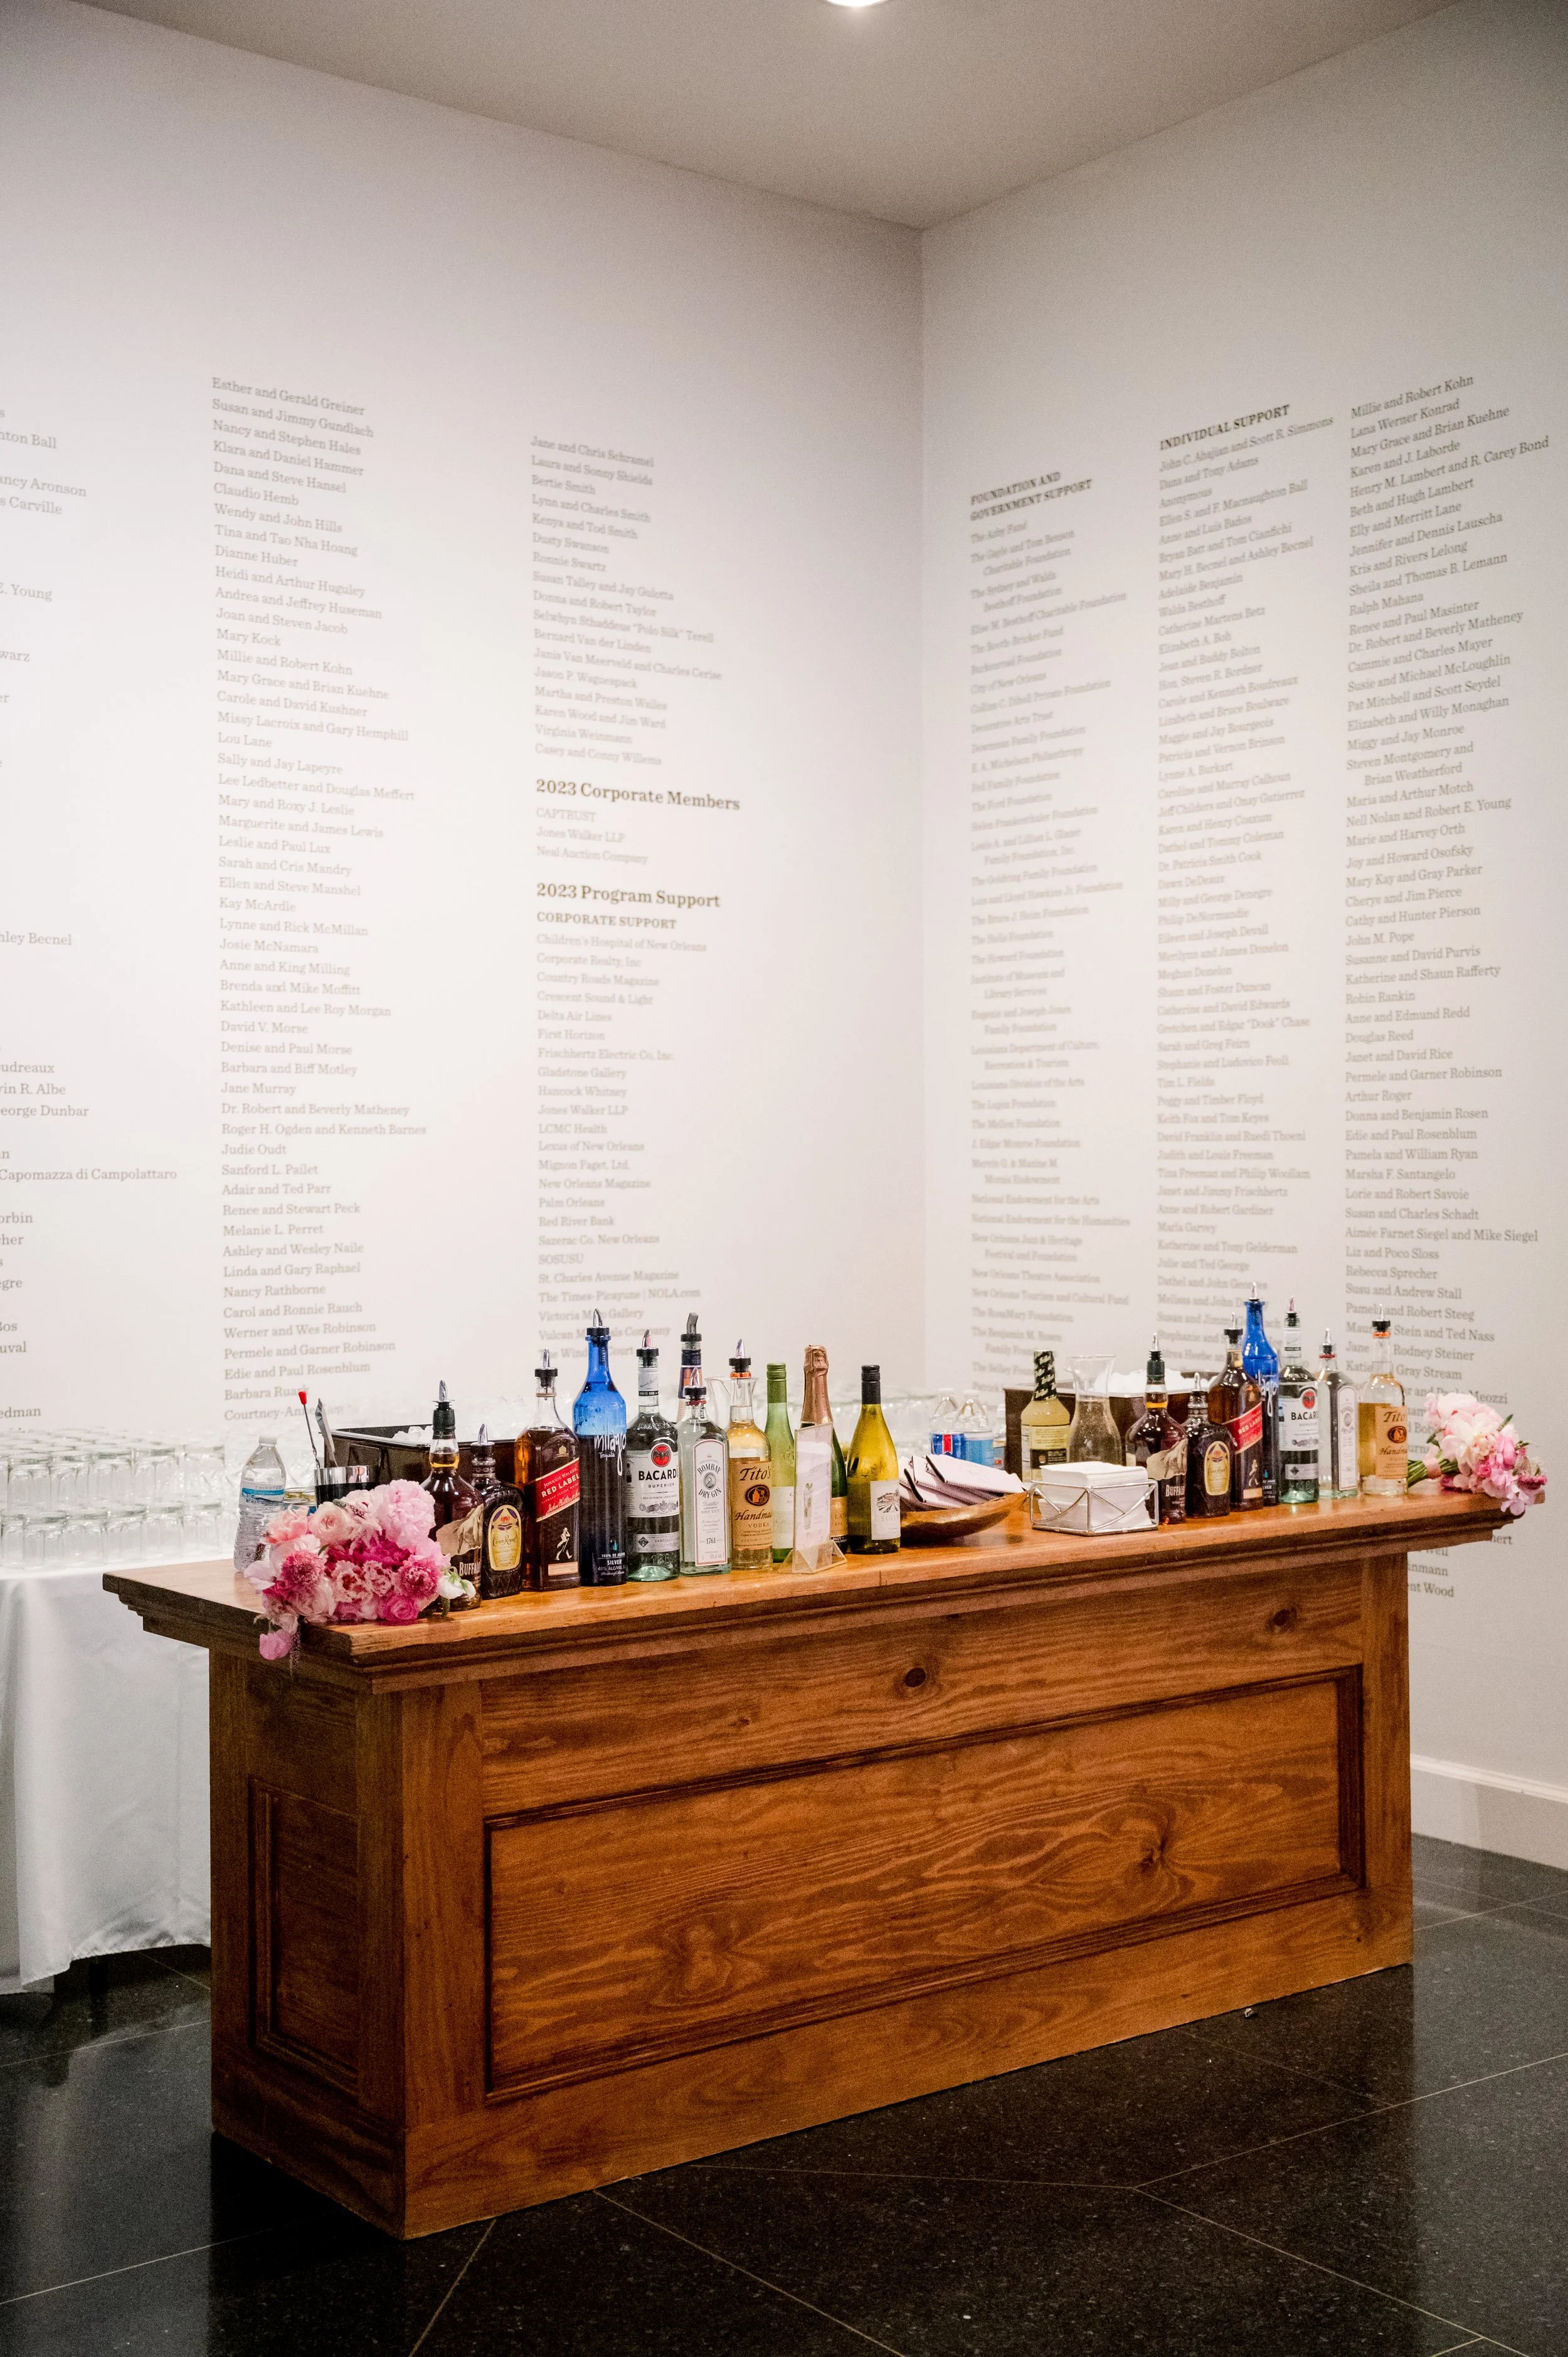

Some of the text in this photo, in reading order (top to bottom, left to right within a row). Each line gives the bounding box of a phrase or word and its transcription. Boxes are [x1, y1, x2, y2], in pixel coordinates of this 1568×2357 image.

[211, 376, 365, 415] Esther and Gerald Greiner
[1351, 376, 1473, 419] Millie and Robert Kohn
[1160, 404, 1290, 450] INDIVIDUAL SUPPORT
[31, 434, 57, 449] Ball
[213, 440, 364, 476] Klara and Daniel Hammer
[30, 478, 87, 497] Aronson
[213, 482, 299, 506] Claudio Hemb
[1350, 478, 1473, 517] Beth and Hugh Lambert
[9, 496, 63, 515] Carville
[11, 584, 53, 602] Young
[215, 586, 382, 619] Andrea and Jeffrey Huseman
[216, 628, 281, 646] Mary Kock
[218, 731, 272, 748] Lou Lane
[217, 753, 343, 775] Sally and Jay Lapeyre
[1364, 761, 1463, 786] Brian Weatherford
[536, 779, 740, 810] 2023 Corporate Members
[536, 807, 596, 822] CAPTRUST
[537, 845, 649, 865] Neal Auction Company
[537, 882, 720, 908] 2023 Program Support
[220, 897, 295, 912] Kay McArdle
[536, 911, 676, 929] CORPORATE SUPPORT
[1345, 907, 1480, 927] Cathy and Hunter Pierson
[28, 933, 72, 945] Becnel
[220, 938, 319, 953] Josie McNamara
[1345, 935, 1371, 946] John
[1389, 931, 1414, 944] Pope
[220, 979, 360, 995] Brenda and Mike Moffitt
[537, 1009, 612, 1022] Delta Air Lines
[1345, 1006, 1470, 1024] Anne and Edmund Redd
[221, 1020, 255, 1032] David
[272, 1022, 308, 1033] Morse
[537, 1066, 627, 1080] Gladstone Gallery
[36, 1083, 66, 1094] Albe
[221, 1082, 296, 1096] Jane Murray
[538, 1085, 627, 1098] Hancock Whitney
[1345, 1089, 1412, 1103] Arthur Roger
[40, 1105, 89, 1116] Dunbar
[538, 1123, 607, 1133] LCMC Health
[221, 1143, 286, 1155] Judie Oudt
[1345, 1148, 1478, 1162] Pamela and William Ryan
[0, 1168, 177, 1182] Capomazza di Campolattaro
[221, 1164, 268, 1175] Sanford
[1345, 1168, 1383, 1179] Marsha
[1397, 1168, 1456, 1182] Santangelo
[223, 1202, 360, 1216] Renee and Stewart Peck
[538, 1216, 615, 1226] Red River Bank
[538, 1253, 584, 1265] SOSUSU
[223, 1284, 326, 1298] Nancy Rathborne
[599, 1452, 615, 1461] Tequila
[697, 1463, 722, 1475] BOMBAY
[739, 1466, 771, 1481] Tito's
[541, 1486, 557, 1498] RED
[558, 1473, 580, 1490] LABEL
[698, 1488, 722, 1499] DRY GIN
[1423, 1582, 1454, 1597] Wood
